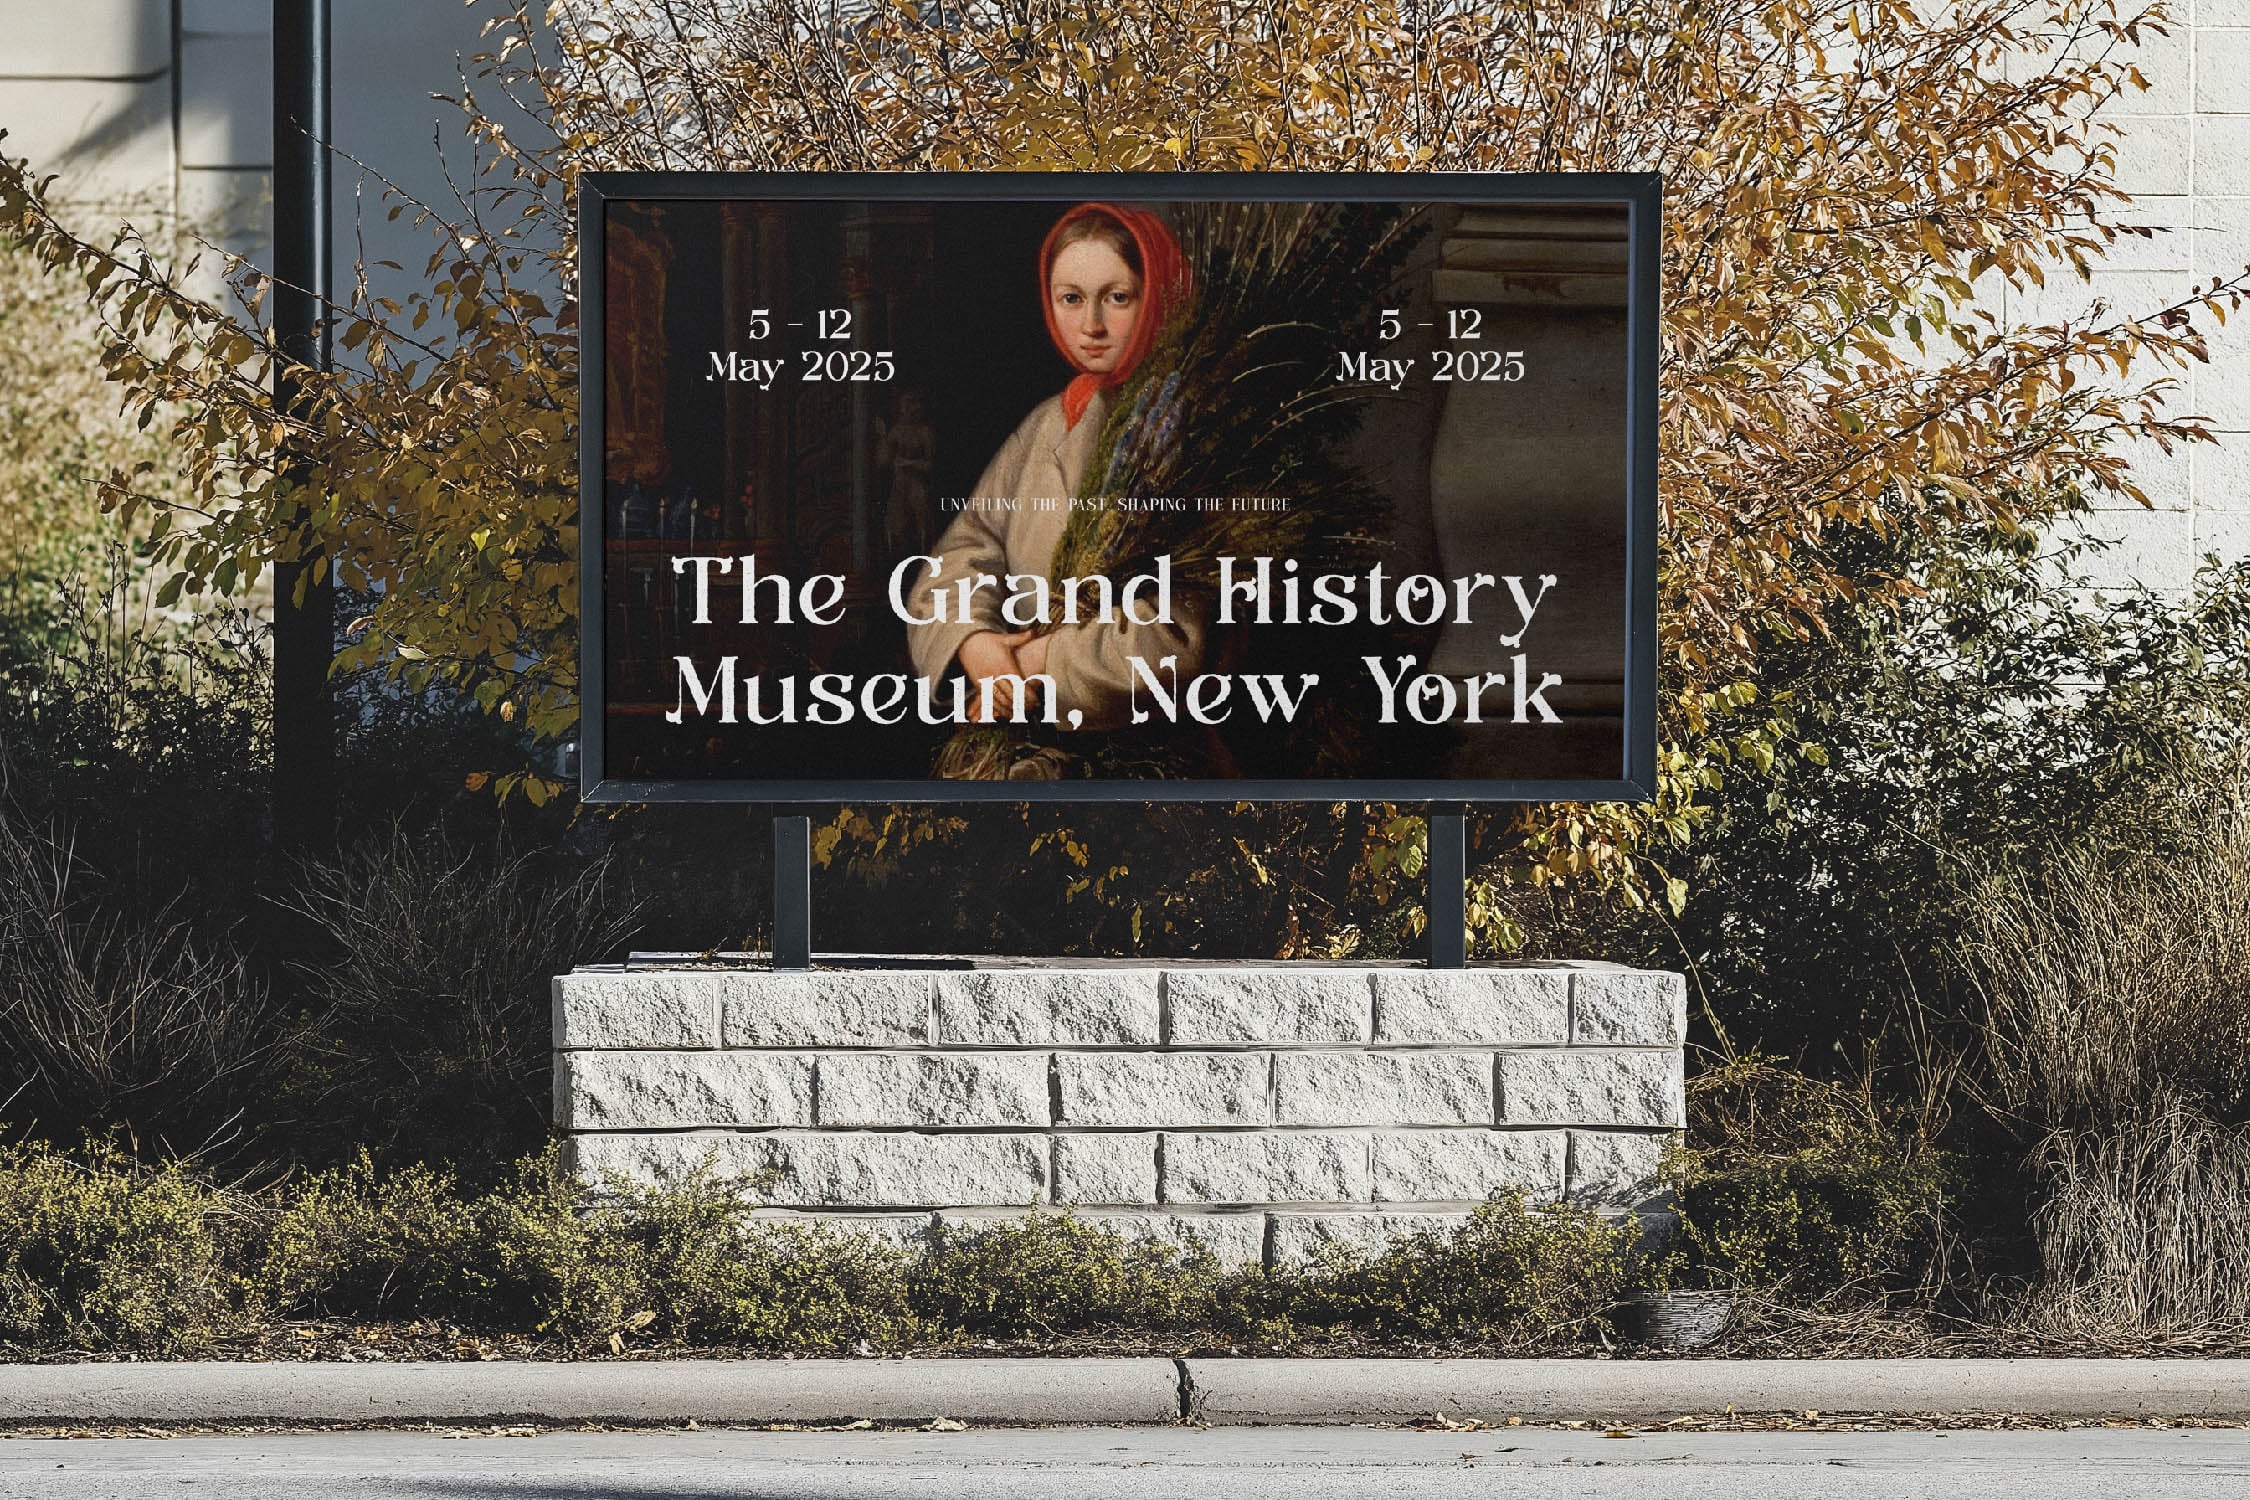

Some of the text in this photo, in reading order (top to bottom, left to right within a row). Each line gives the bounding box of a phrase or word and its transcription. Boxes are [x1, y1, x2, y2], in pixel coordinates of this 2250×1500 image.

[749, 308, 770, 340] 5
[818, 308, 852, 339] 12
[1379, 308, 1401, 340] 5
[1447, 308, 1482, 339] 12
[705, 350, 895, 392] May 2025
[1335, 350, 1525, 391] May 2025
[940, 496, 1291, 512] UNVEILING THE PAST SHAPING THE FUTURE
[671, 554, 1557, 649] The Grand History
[665, 653, 1563, 730] Museum, New York
